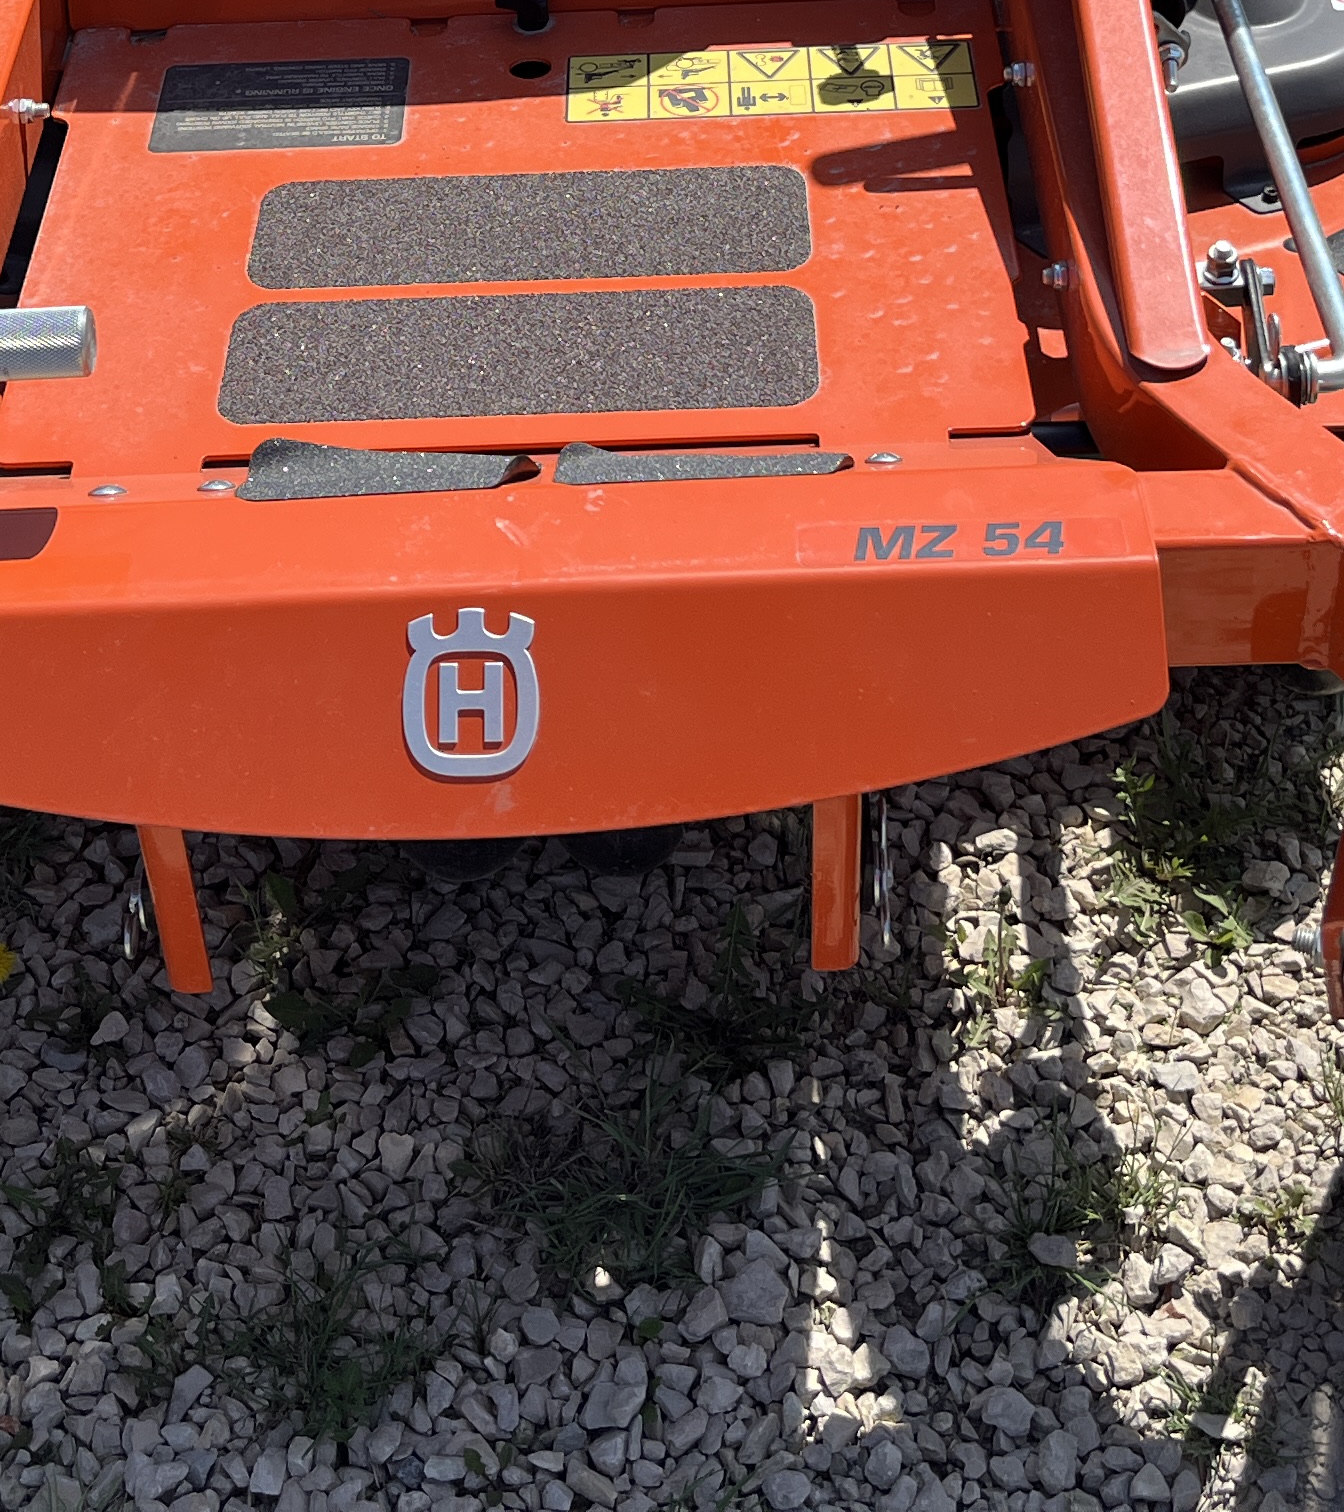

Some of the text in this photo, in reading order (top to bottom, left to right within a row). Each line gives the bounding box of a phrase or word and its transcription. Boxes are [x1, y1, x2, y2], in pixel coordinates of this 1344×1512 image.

[330, 132, 387, 142] TO START
[853, 520, 1065, 562] MZ 54
